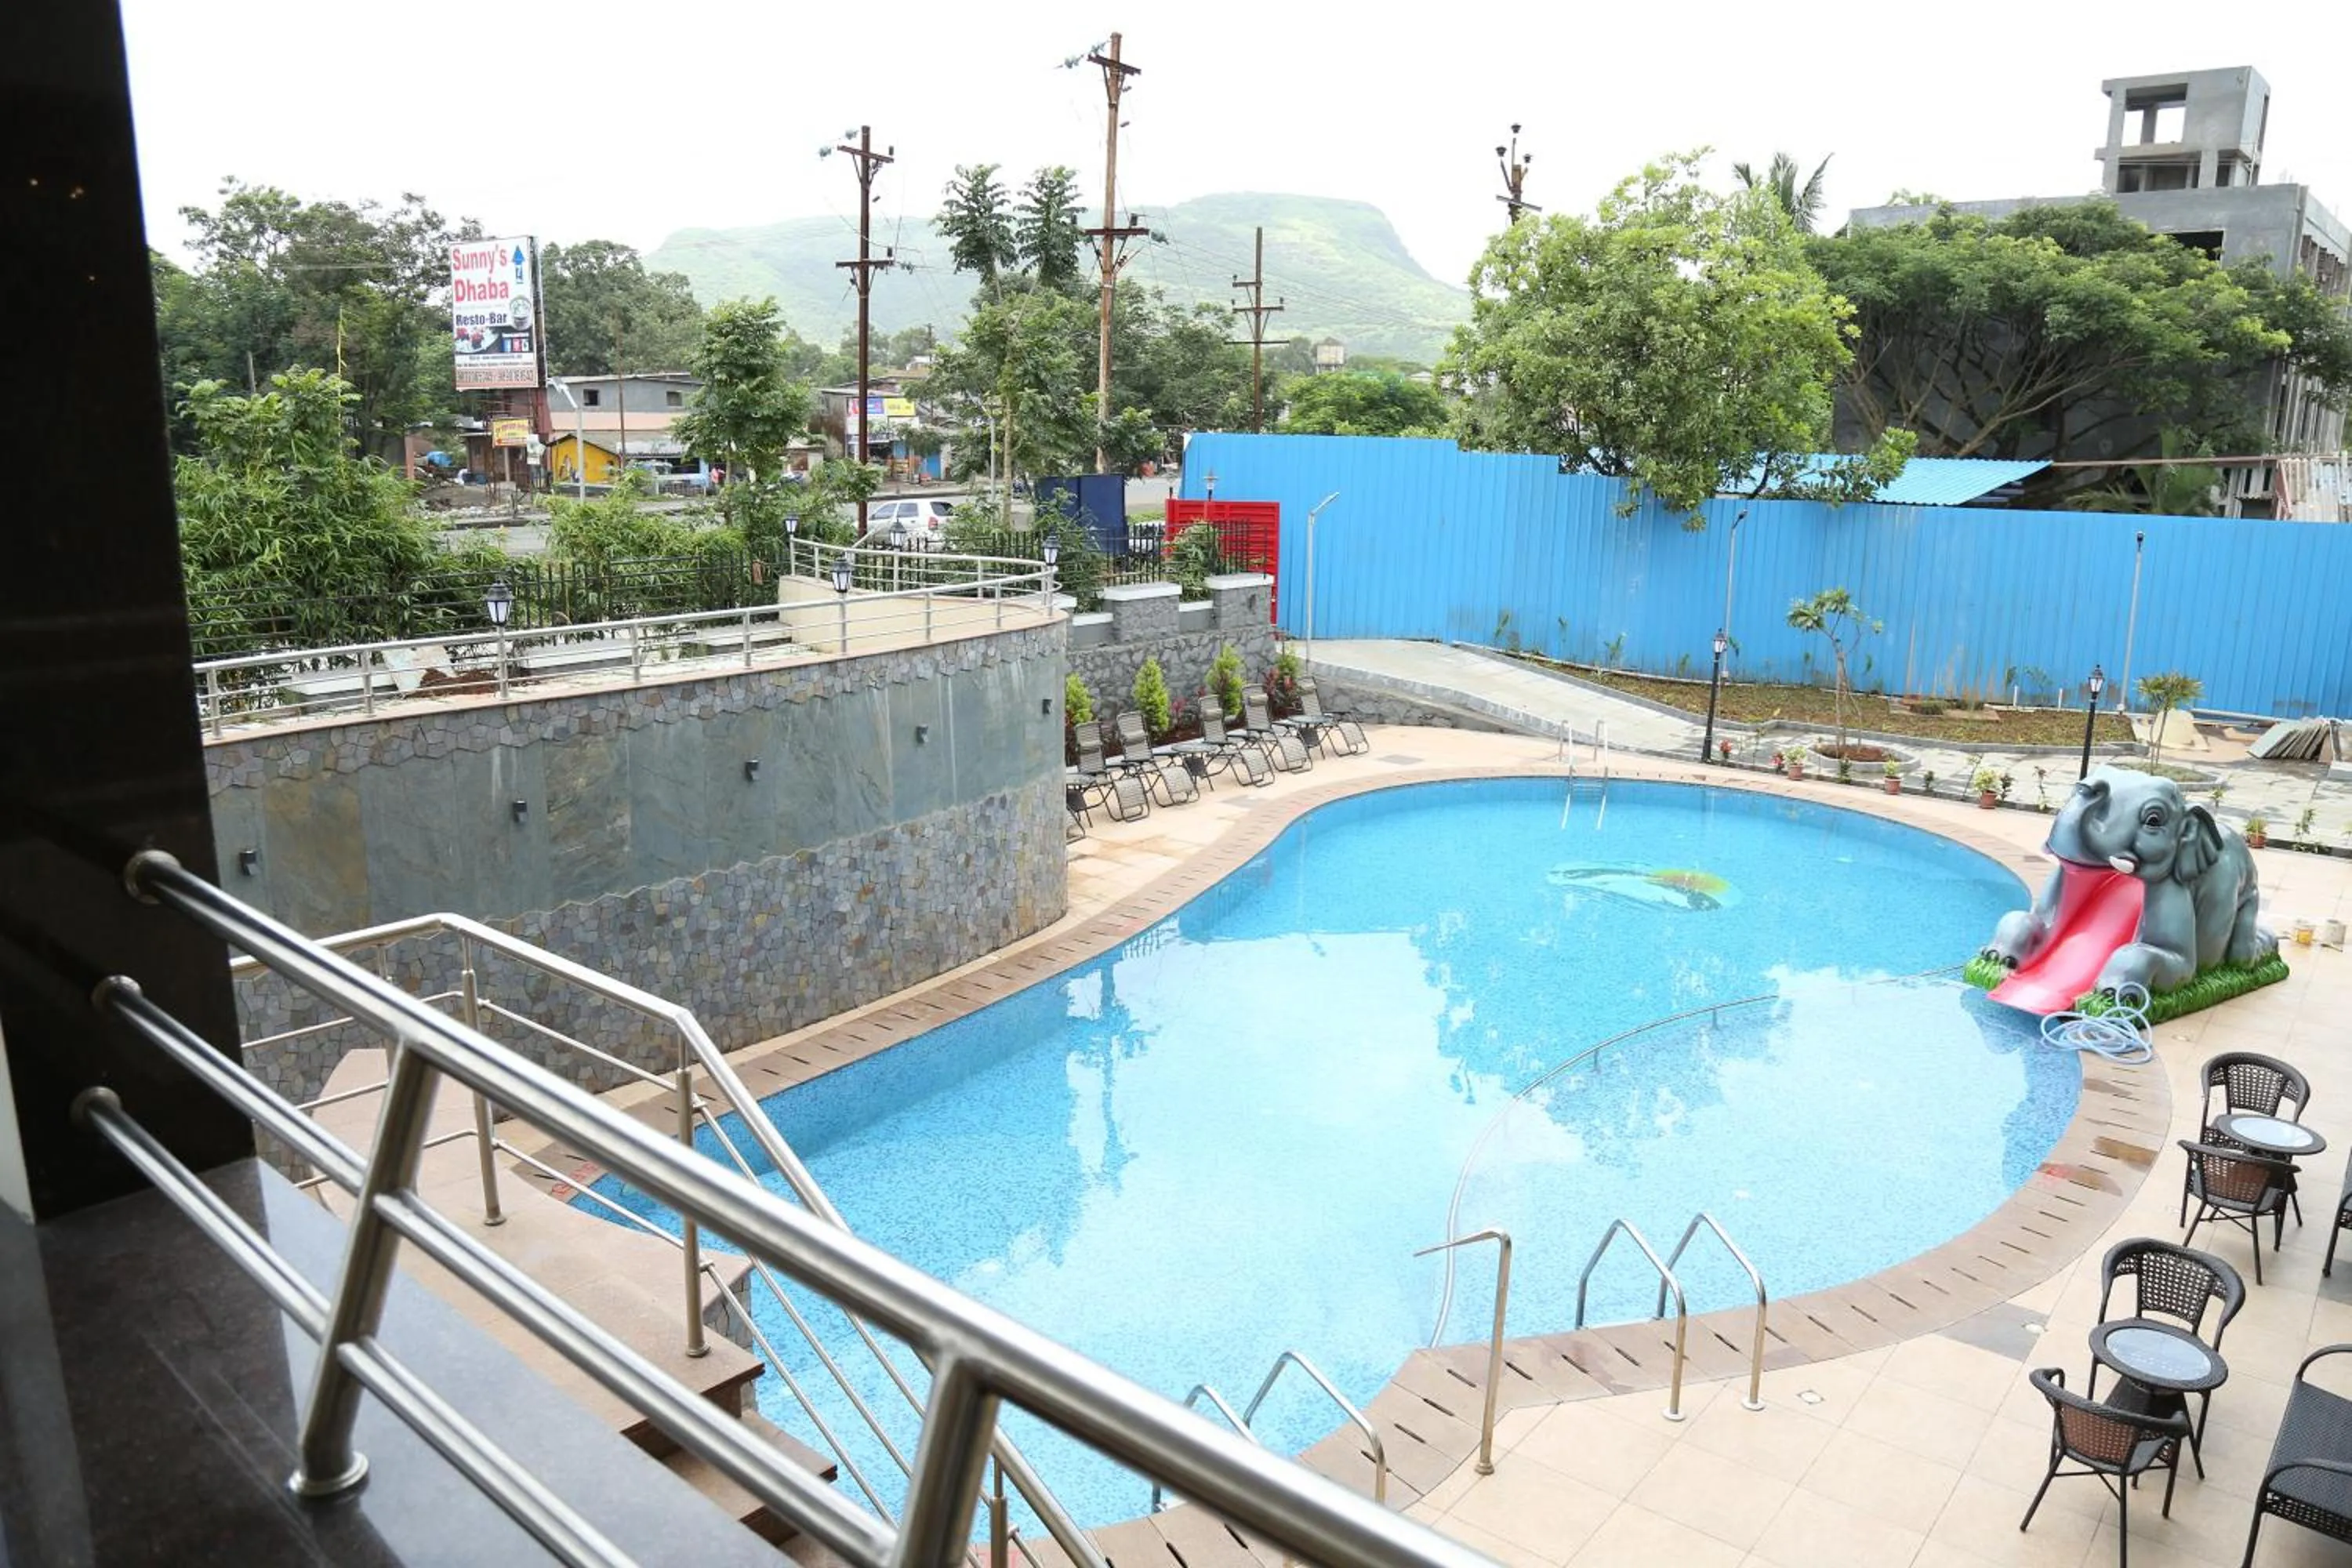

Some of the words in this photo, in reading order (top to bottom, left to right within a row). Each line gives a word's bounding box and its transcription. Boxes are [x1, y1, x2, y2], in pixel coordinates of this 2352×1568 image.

[452, 244, 507, 274] Sunny's
[455, 277, 509, 302] Dhaba
[456, 313, 506, 325] Resto-Bar
